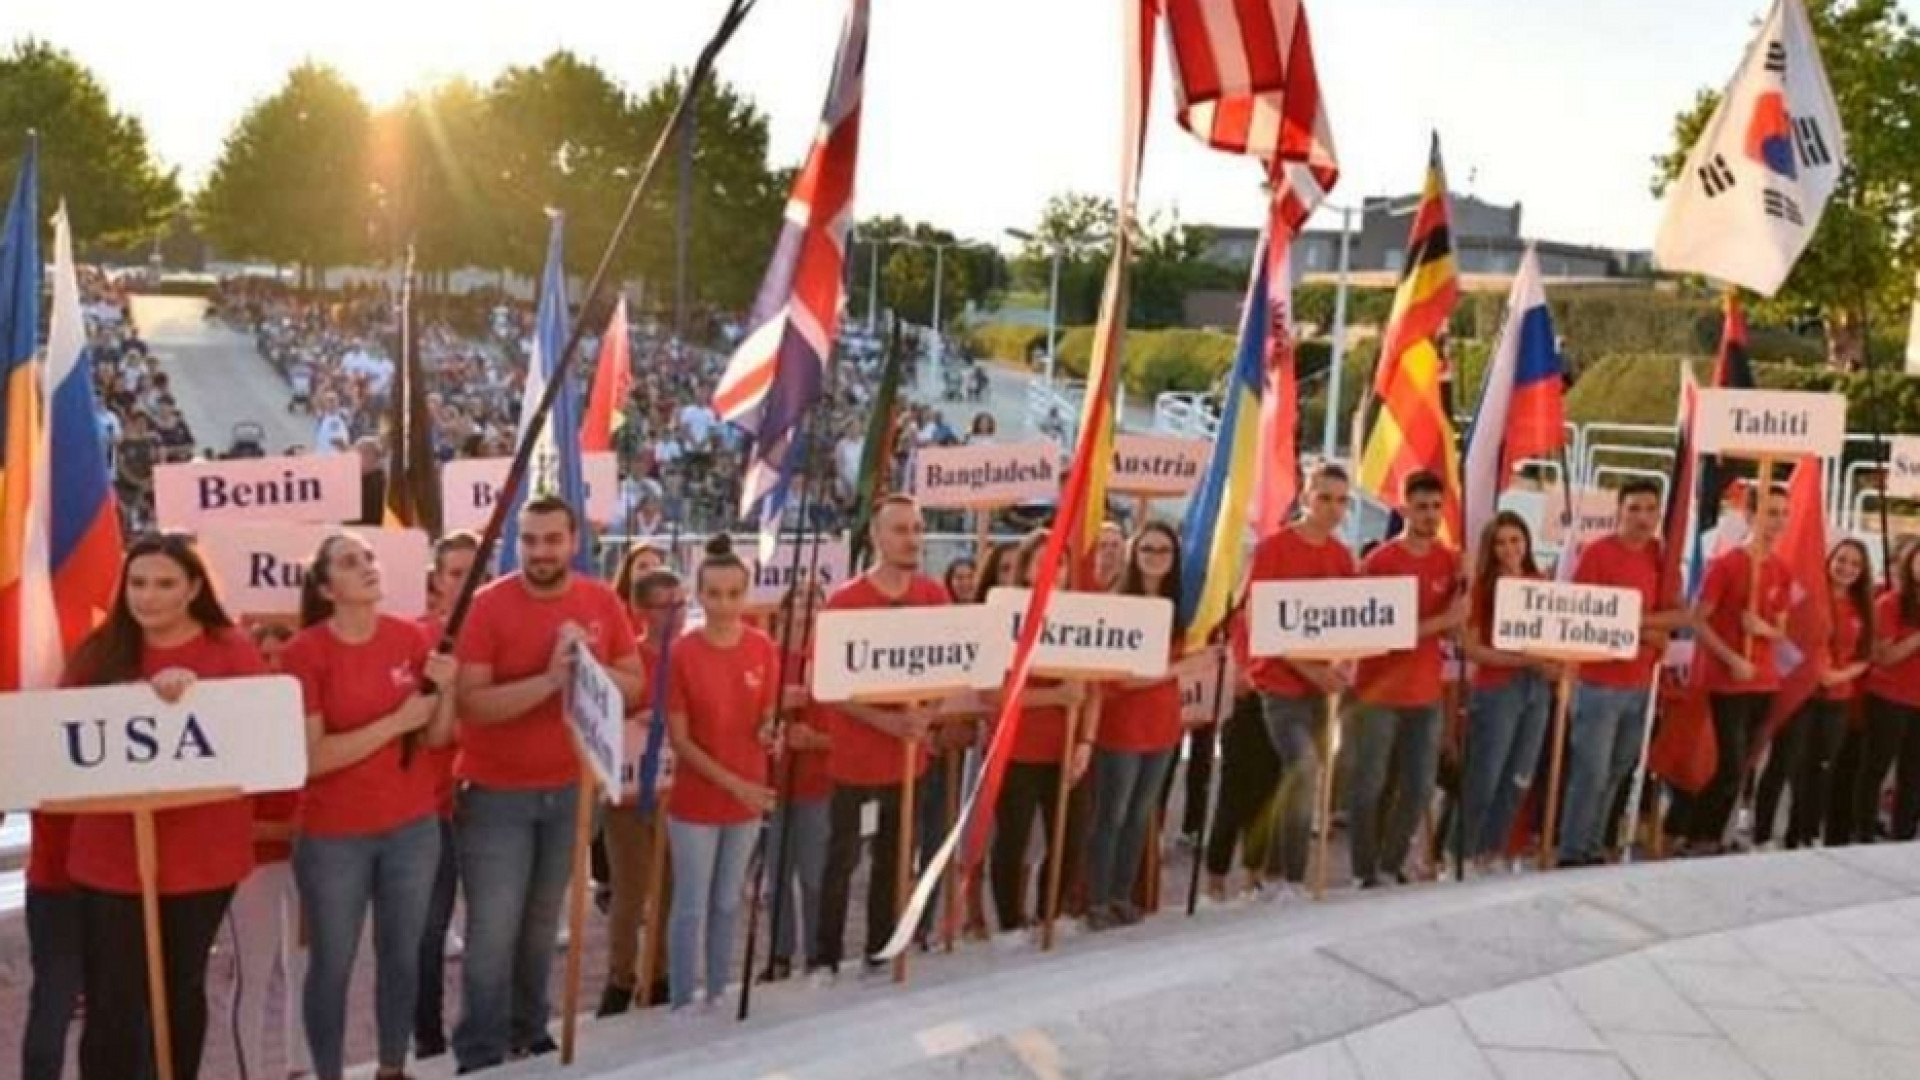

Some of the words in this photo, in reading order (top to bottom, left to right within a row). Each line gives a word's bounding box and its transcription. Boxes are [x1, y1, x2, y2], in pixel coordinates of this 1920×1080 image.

[1729, 407, 1809, 436] Tahiti
[926, 458, 1053, 488] Bangladesh
[199, 471, 322, 509] Benin
[1278, 597, 1395, 638] Uganda
[1522, 586, 1618, 616] Trinidad
[1499, 617, 1542, 638] and
[1559, 619, 1635, 647] Tobago
[845, 639, 981, 675] Uruguay
[62, 712, 217, 768] USA
